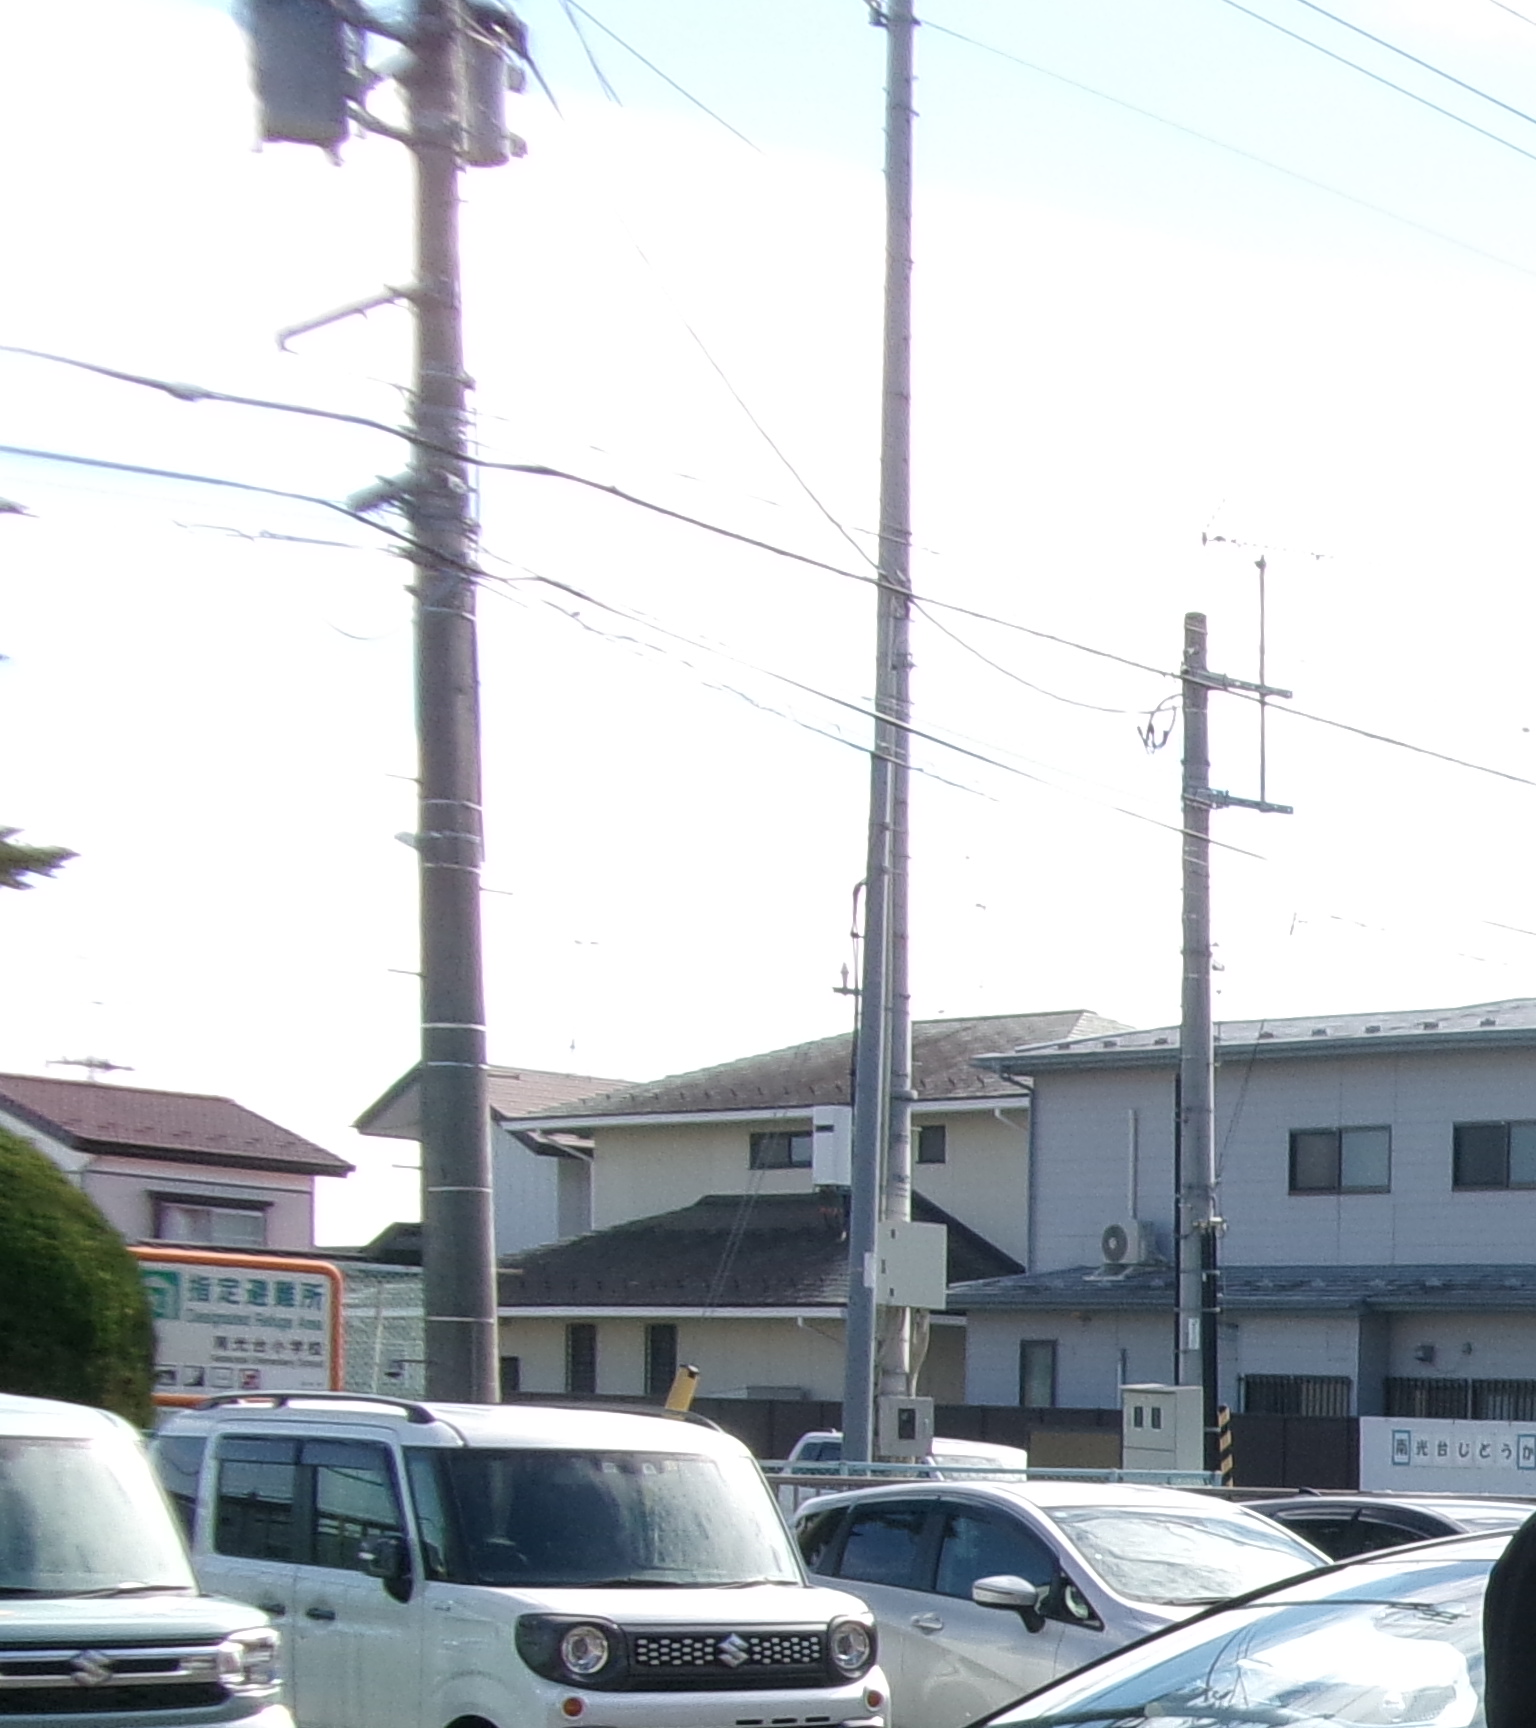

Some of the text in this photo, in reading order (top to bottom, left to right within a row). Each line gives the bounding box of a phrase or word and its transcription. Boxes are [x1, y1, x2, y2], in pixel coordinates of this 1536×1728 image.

[187, 1275, 324, 1311] 指定避難所
